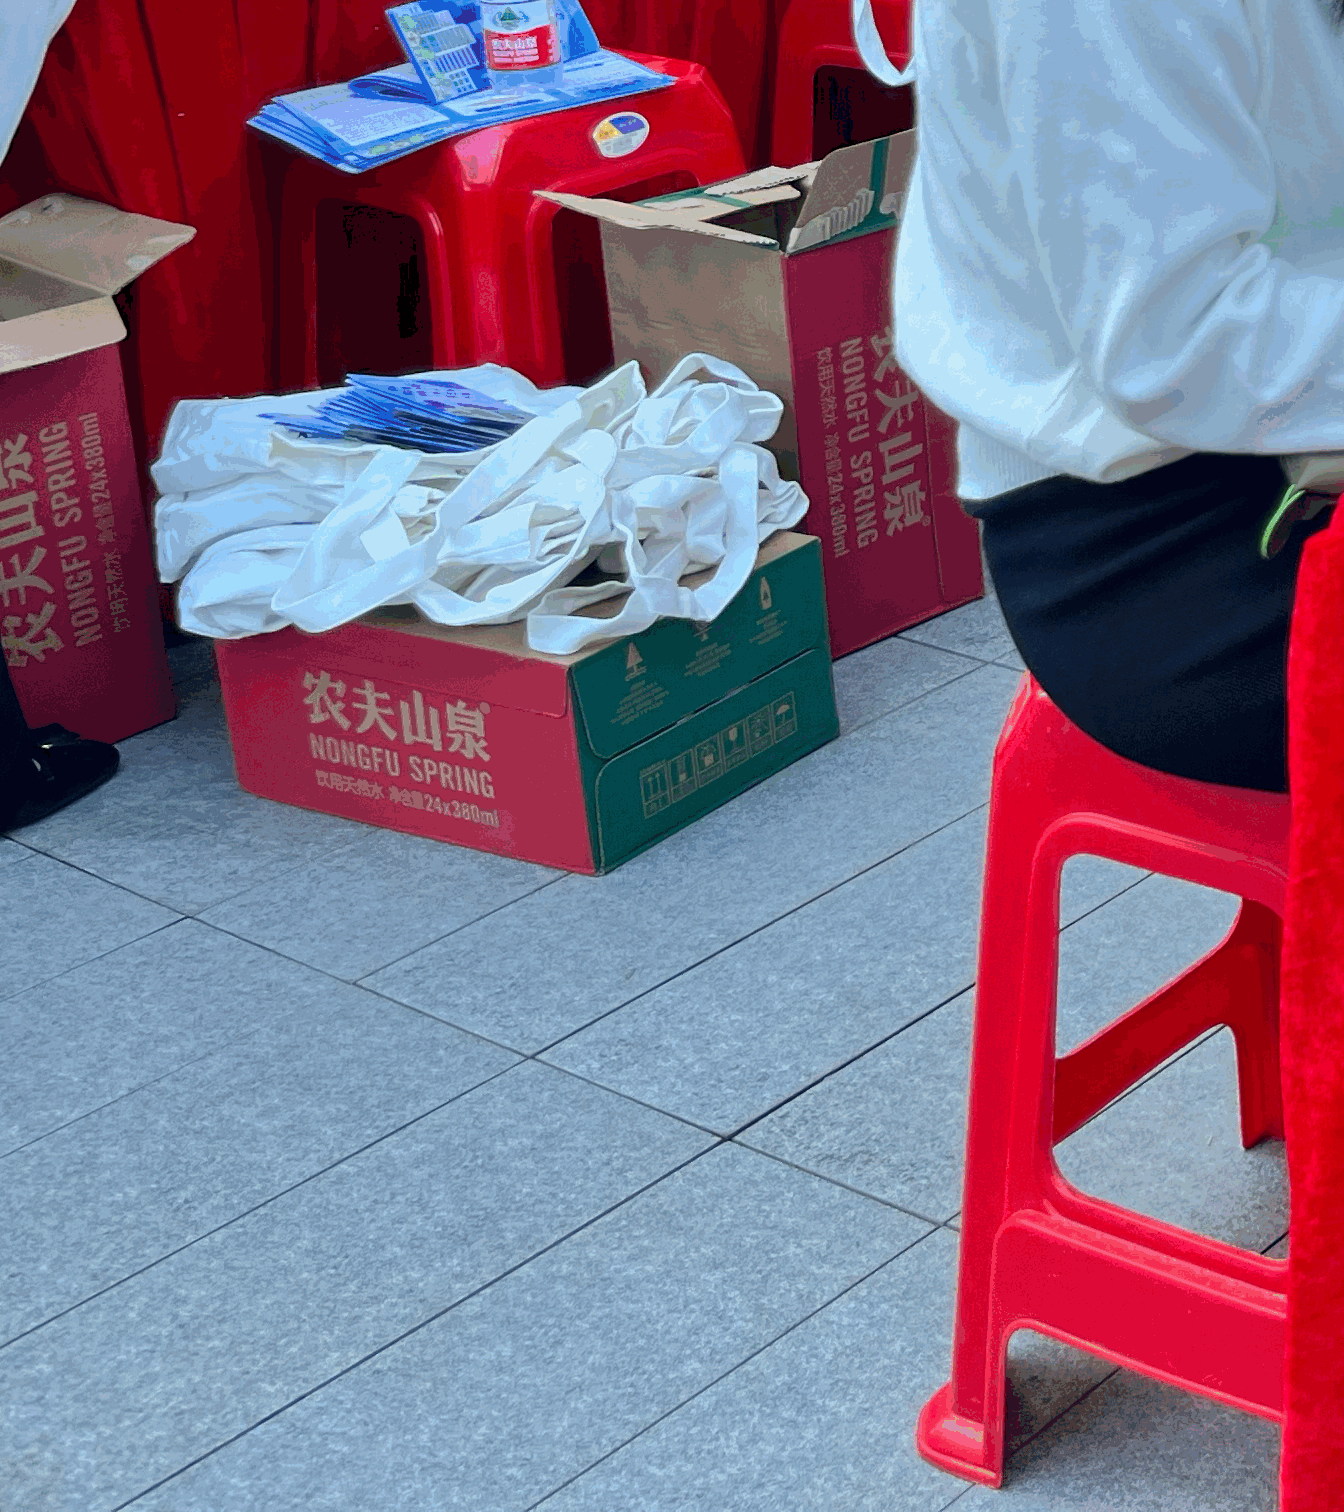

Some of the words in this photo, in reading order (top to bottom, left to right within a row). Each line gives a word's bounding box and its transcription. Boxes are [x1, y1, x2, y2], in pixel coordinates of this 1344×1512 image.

[839, 336, 870, 443] NONGFU
[38, 421, 83, 528] SPRING
[850, 450, 879, 549] SPRING
[57, 535, 103, 647] NONGFU
[303, 670, 491, 763] 农夫山泉
[309, 732, 401, 777] NONGFU
[408, 755, 496, 800] SPRING
